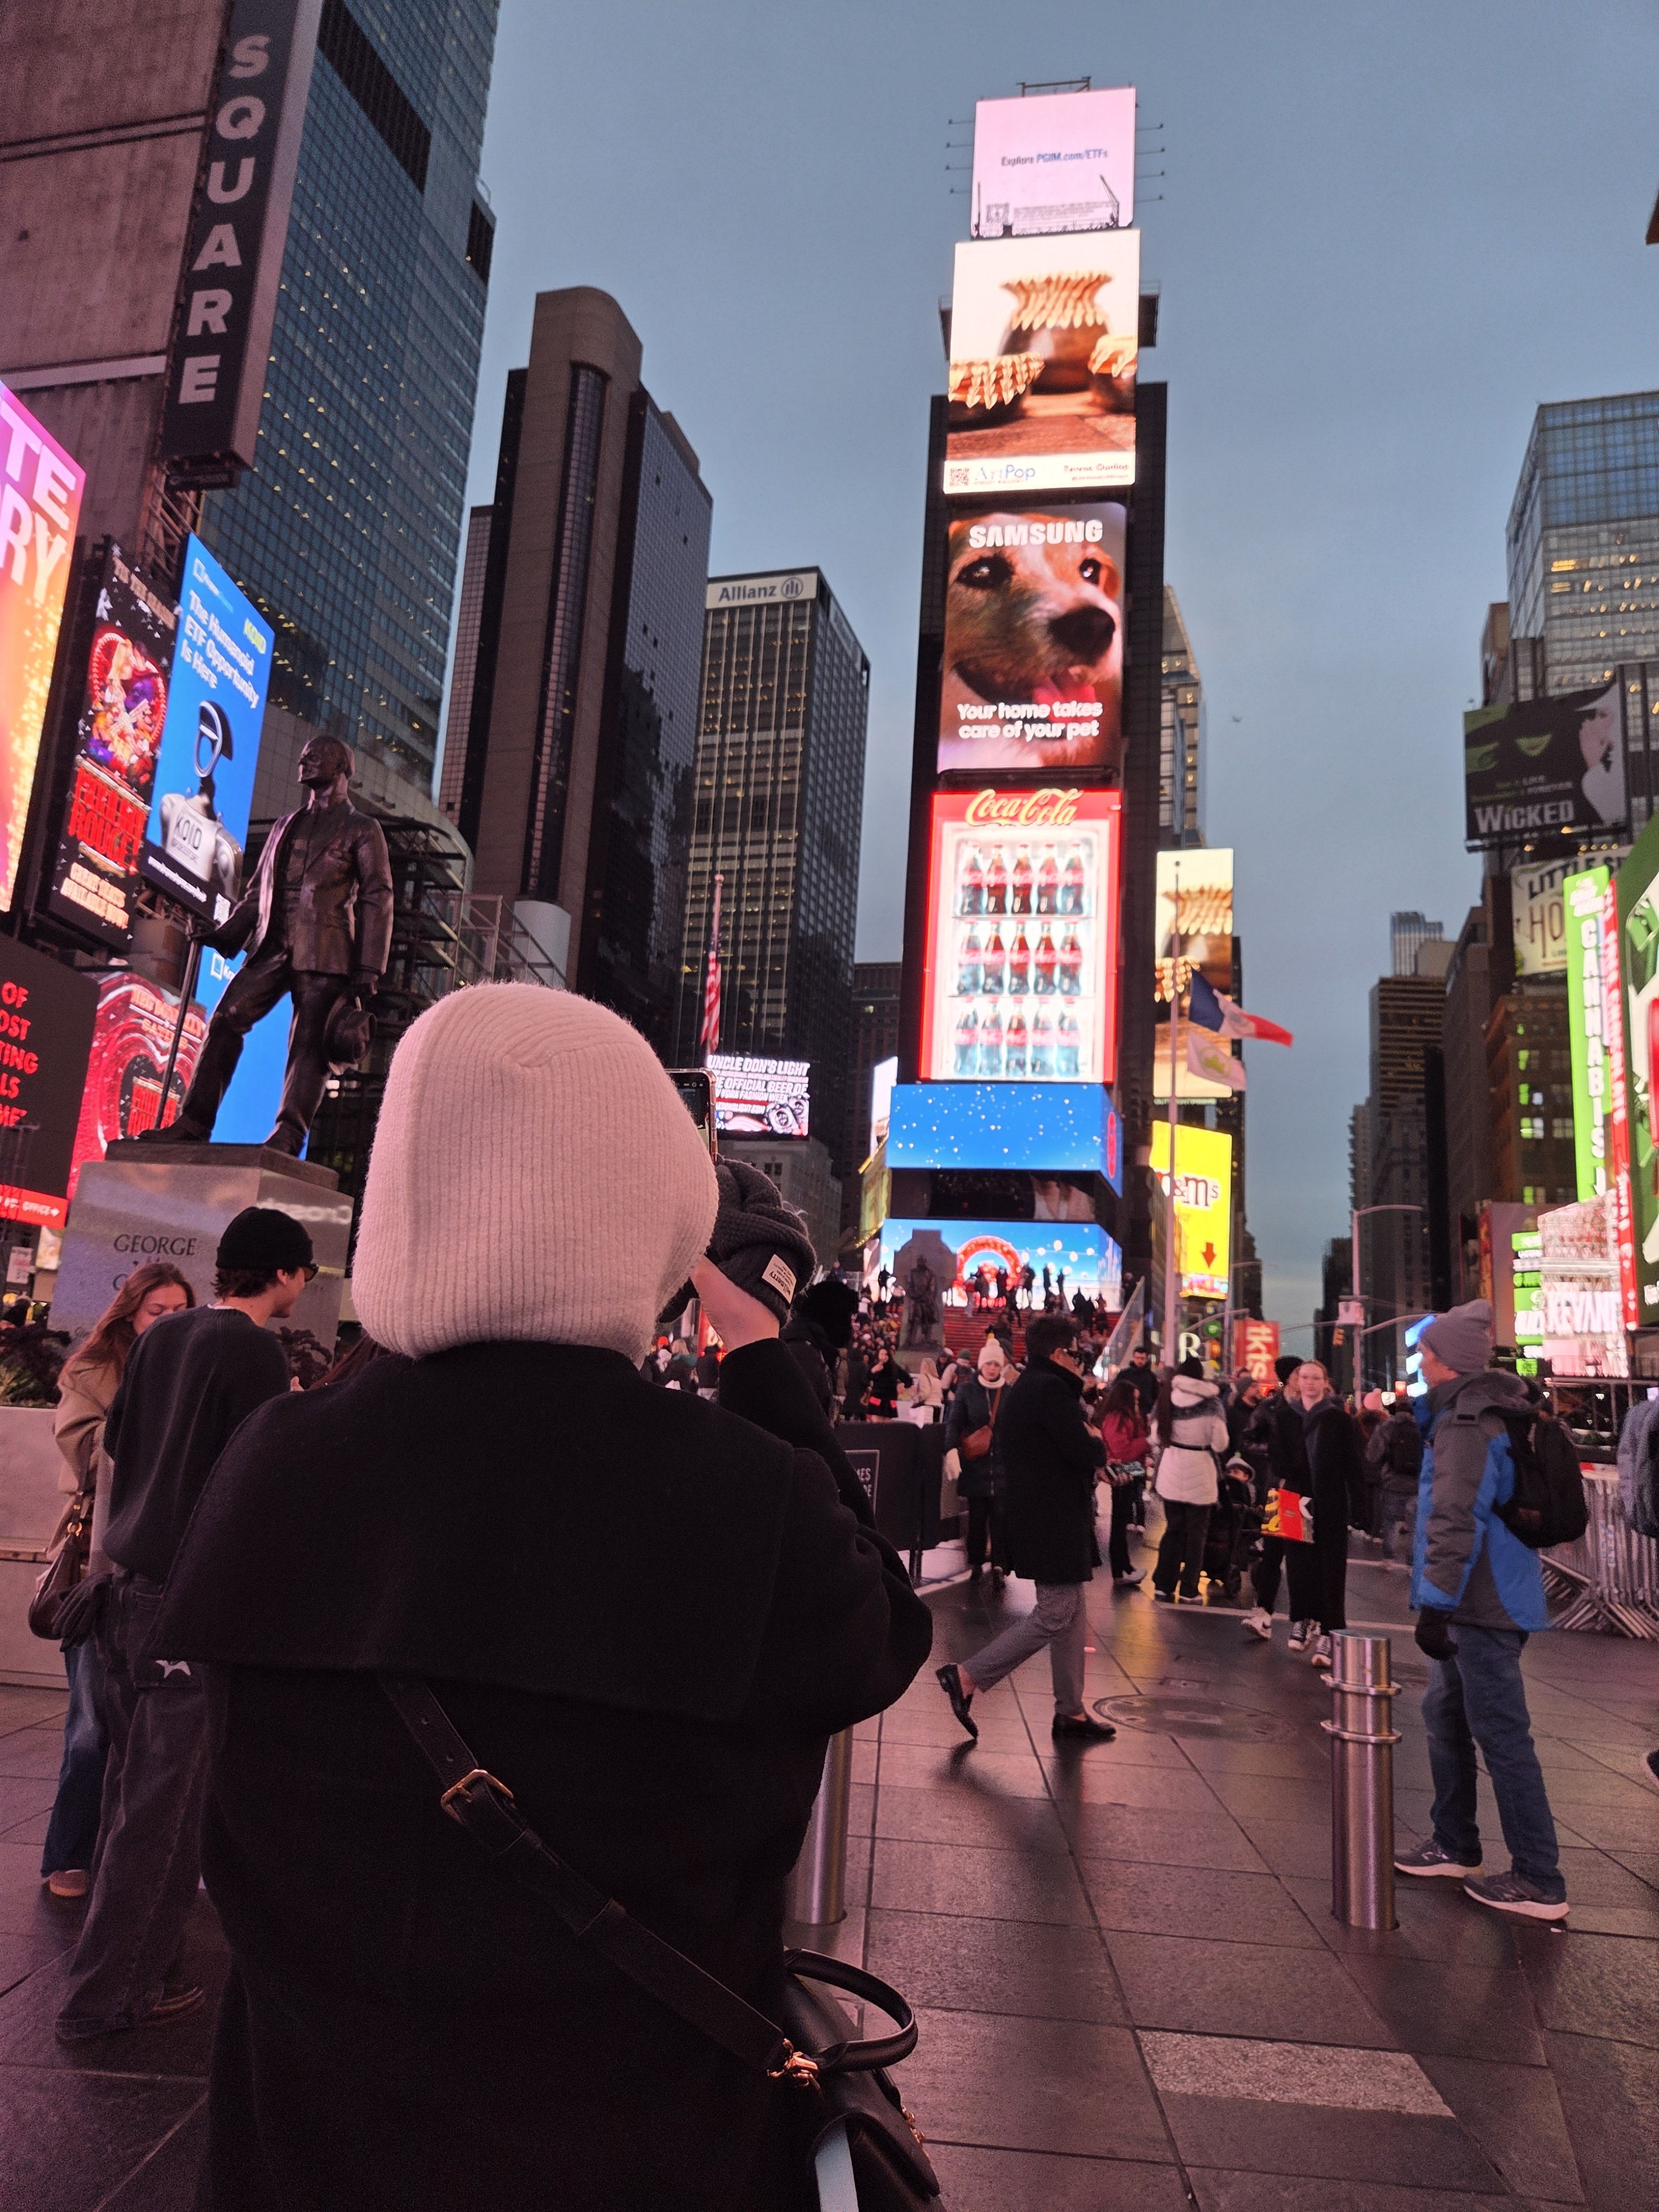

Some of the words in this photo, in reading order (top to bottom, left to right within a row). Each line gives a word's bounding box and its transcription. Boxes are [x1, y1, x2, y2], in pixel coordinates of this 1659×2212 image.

[1001, 156, 1035, 168] Explore
[178, 34, 272, 405] SQUARE
[974, 464, 1036, 482] ArtPop
[969, 519, 1103, 549] SAMSUNG
[718, 585, 777, 602] Allianz
[189, 588, 209, 625] The
[208, 612, 255, 676] Humanoid
[184, 613, 208, 647] ETF
[205, 638, 260, 709] Opportunity
[191, 649, 218, 689] Here
[957, 703, 998, 721] Your
[998, 702, 1051, 719] home
[1052, 700, 1103, 717] takes
[958, 724, 1001, 739] care
[1002, 720, 1024, 738] of
[1024, 722, 1066, 742] your
[1066, 719, 1100, 741] pet
[175, 811, 202, 851] KOID
[2, 981, 28, 1008] OF
[1580, 919, 1605, 1159] CANNABIS
[707, 1054, 744, 1072] UNCLE
[776, 1060, 811, 1077] LIGHT
[720, 1088, 740, 1099] YORK
[738, 1090, 769, 1102] FASHION
[723, 1077, 766, 1092] OFFICIAL
[767, 1081, 794, 1095] BEER
[114, 1234, 197, 1256] GEORGE
[1246, 1325, 1275, 1381] tkts
